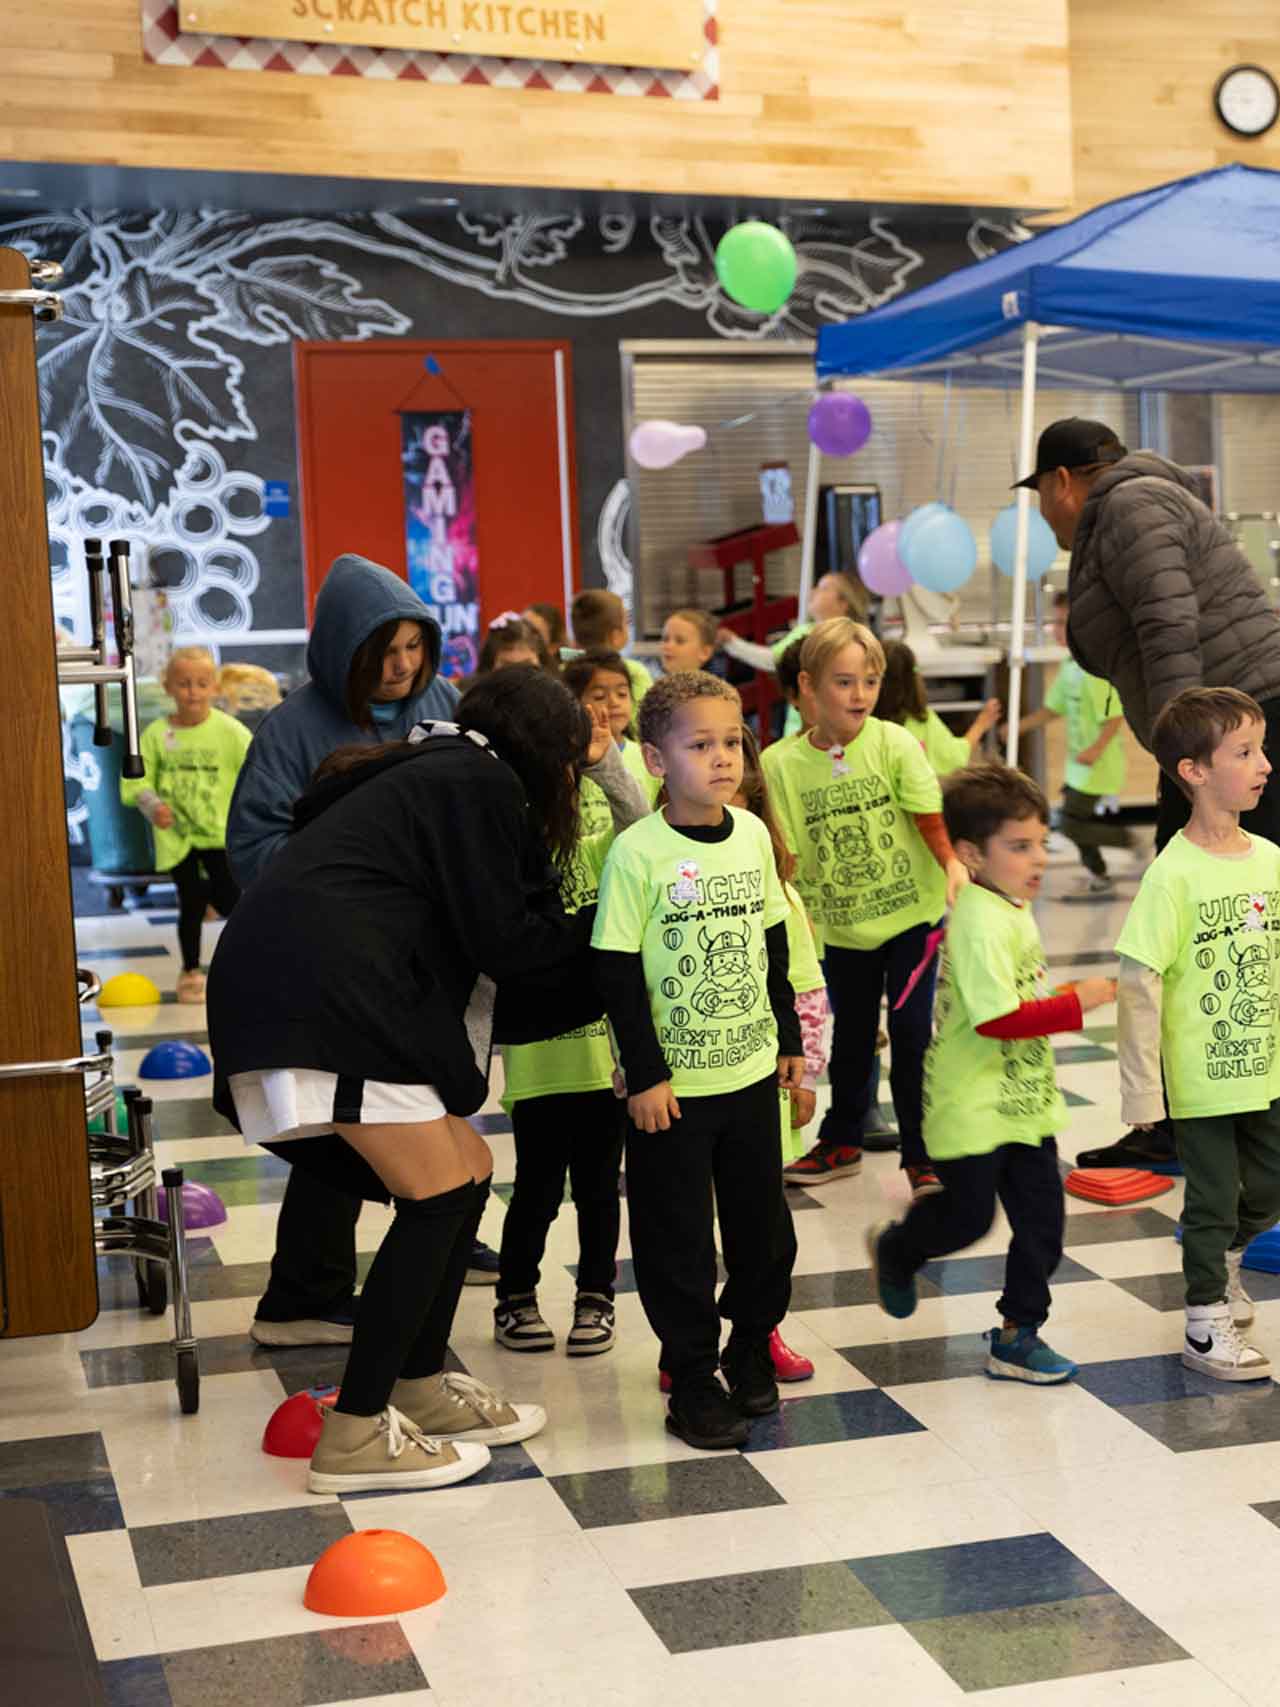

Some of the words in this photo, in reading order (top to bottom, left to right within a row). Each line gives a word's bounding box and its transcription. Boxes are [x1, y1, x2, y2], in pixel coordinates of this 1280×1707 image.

[291, 0, 447, 29] SCRATCH
[463, 2, 606, 41] KITCHEN
[421, 425, 457, 603] GAMING
[801, 775, 881, 812] VICHY
[661, 904, 746, 925] JOG-A-THON
[660, 1027, 721, 1047] NEXT
[1205, 1037, 1262, 1060] NEXT
